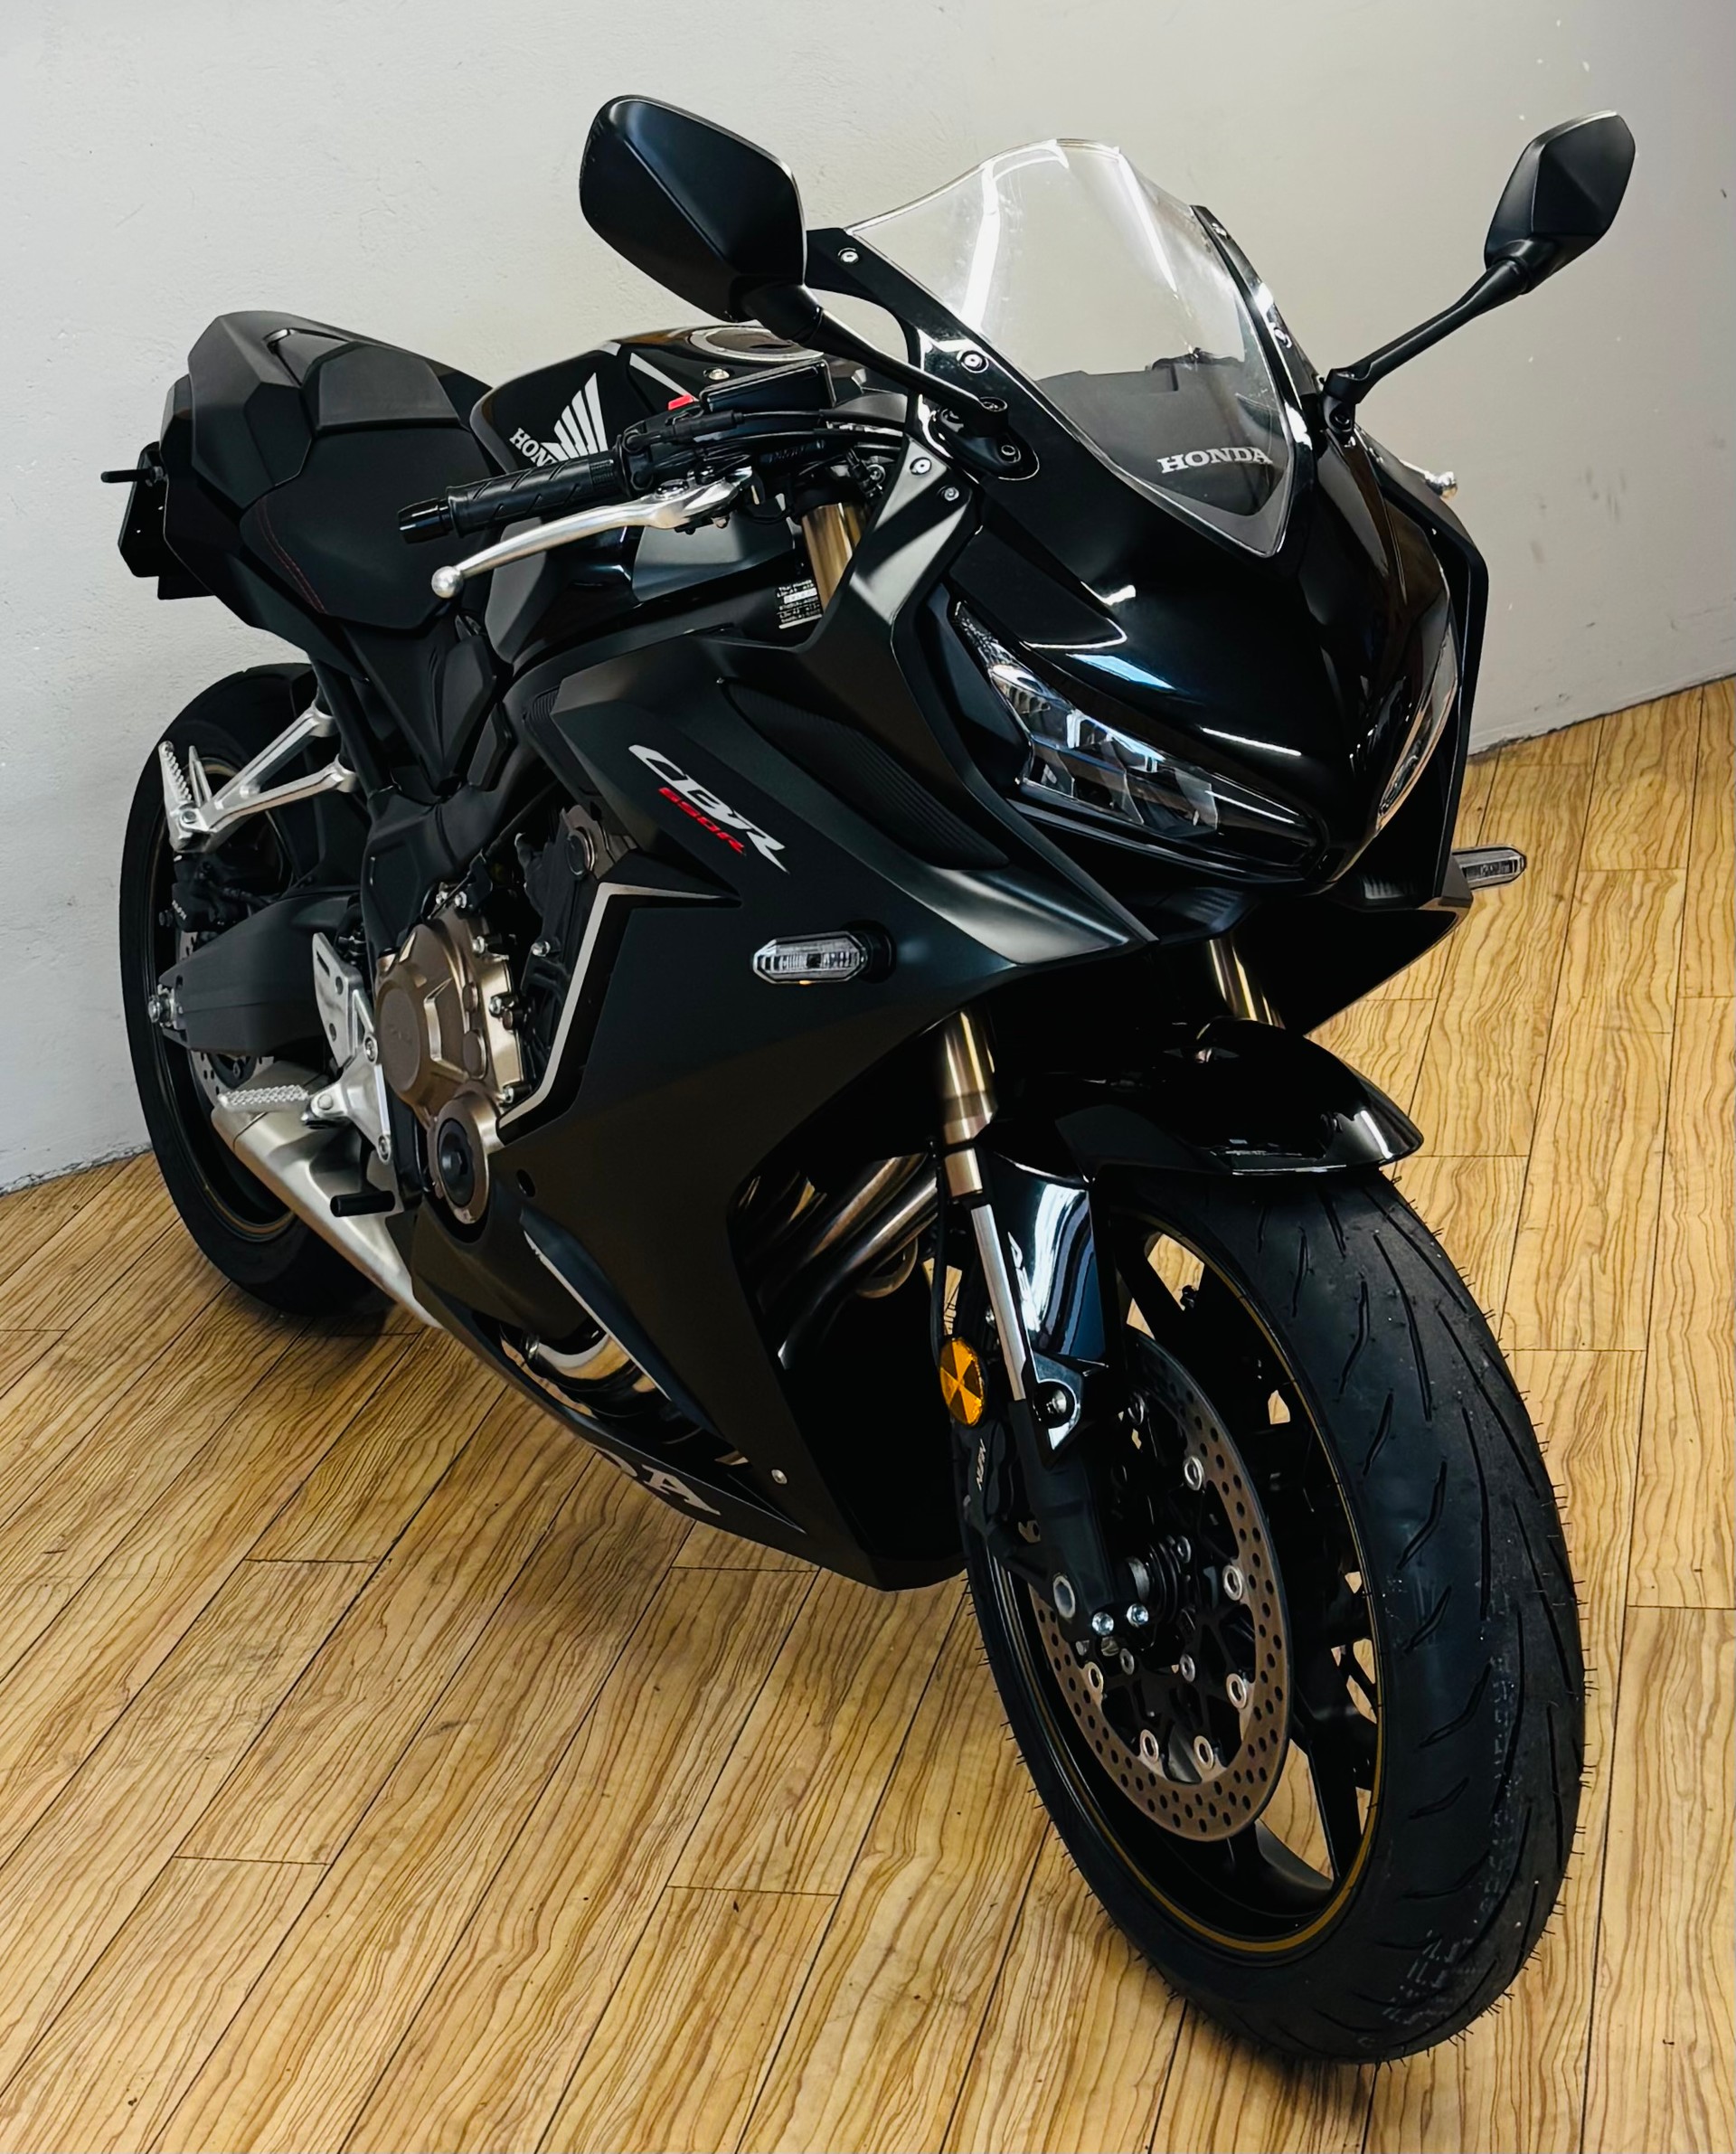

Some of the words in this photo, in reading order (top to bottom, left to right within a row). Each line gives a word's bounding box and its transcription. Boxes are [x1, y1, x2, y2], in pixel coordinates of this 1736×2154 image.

[509, 427, 558, 468] HON
[1156, 447, 1273, 474] HONDA
[628, 744, 790, 874] CBR
